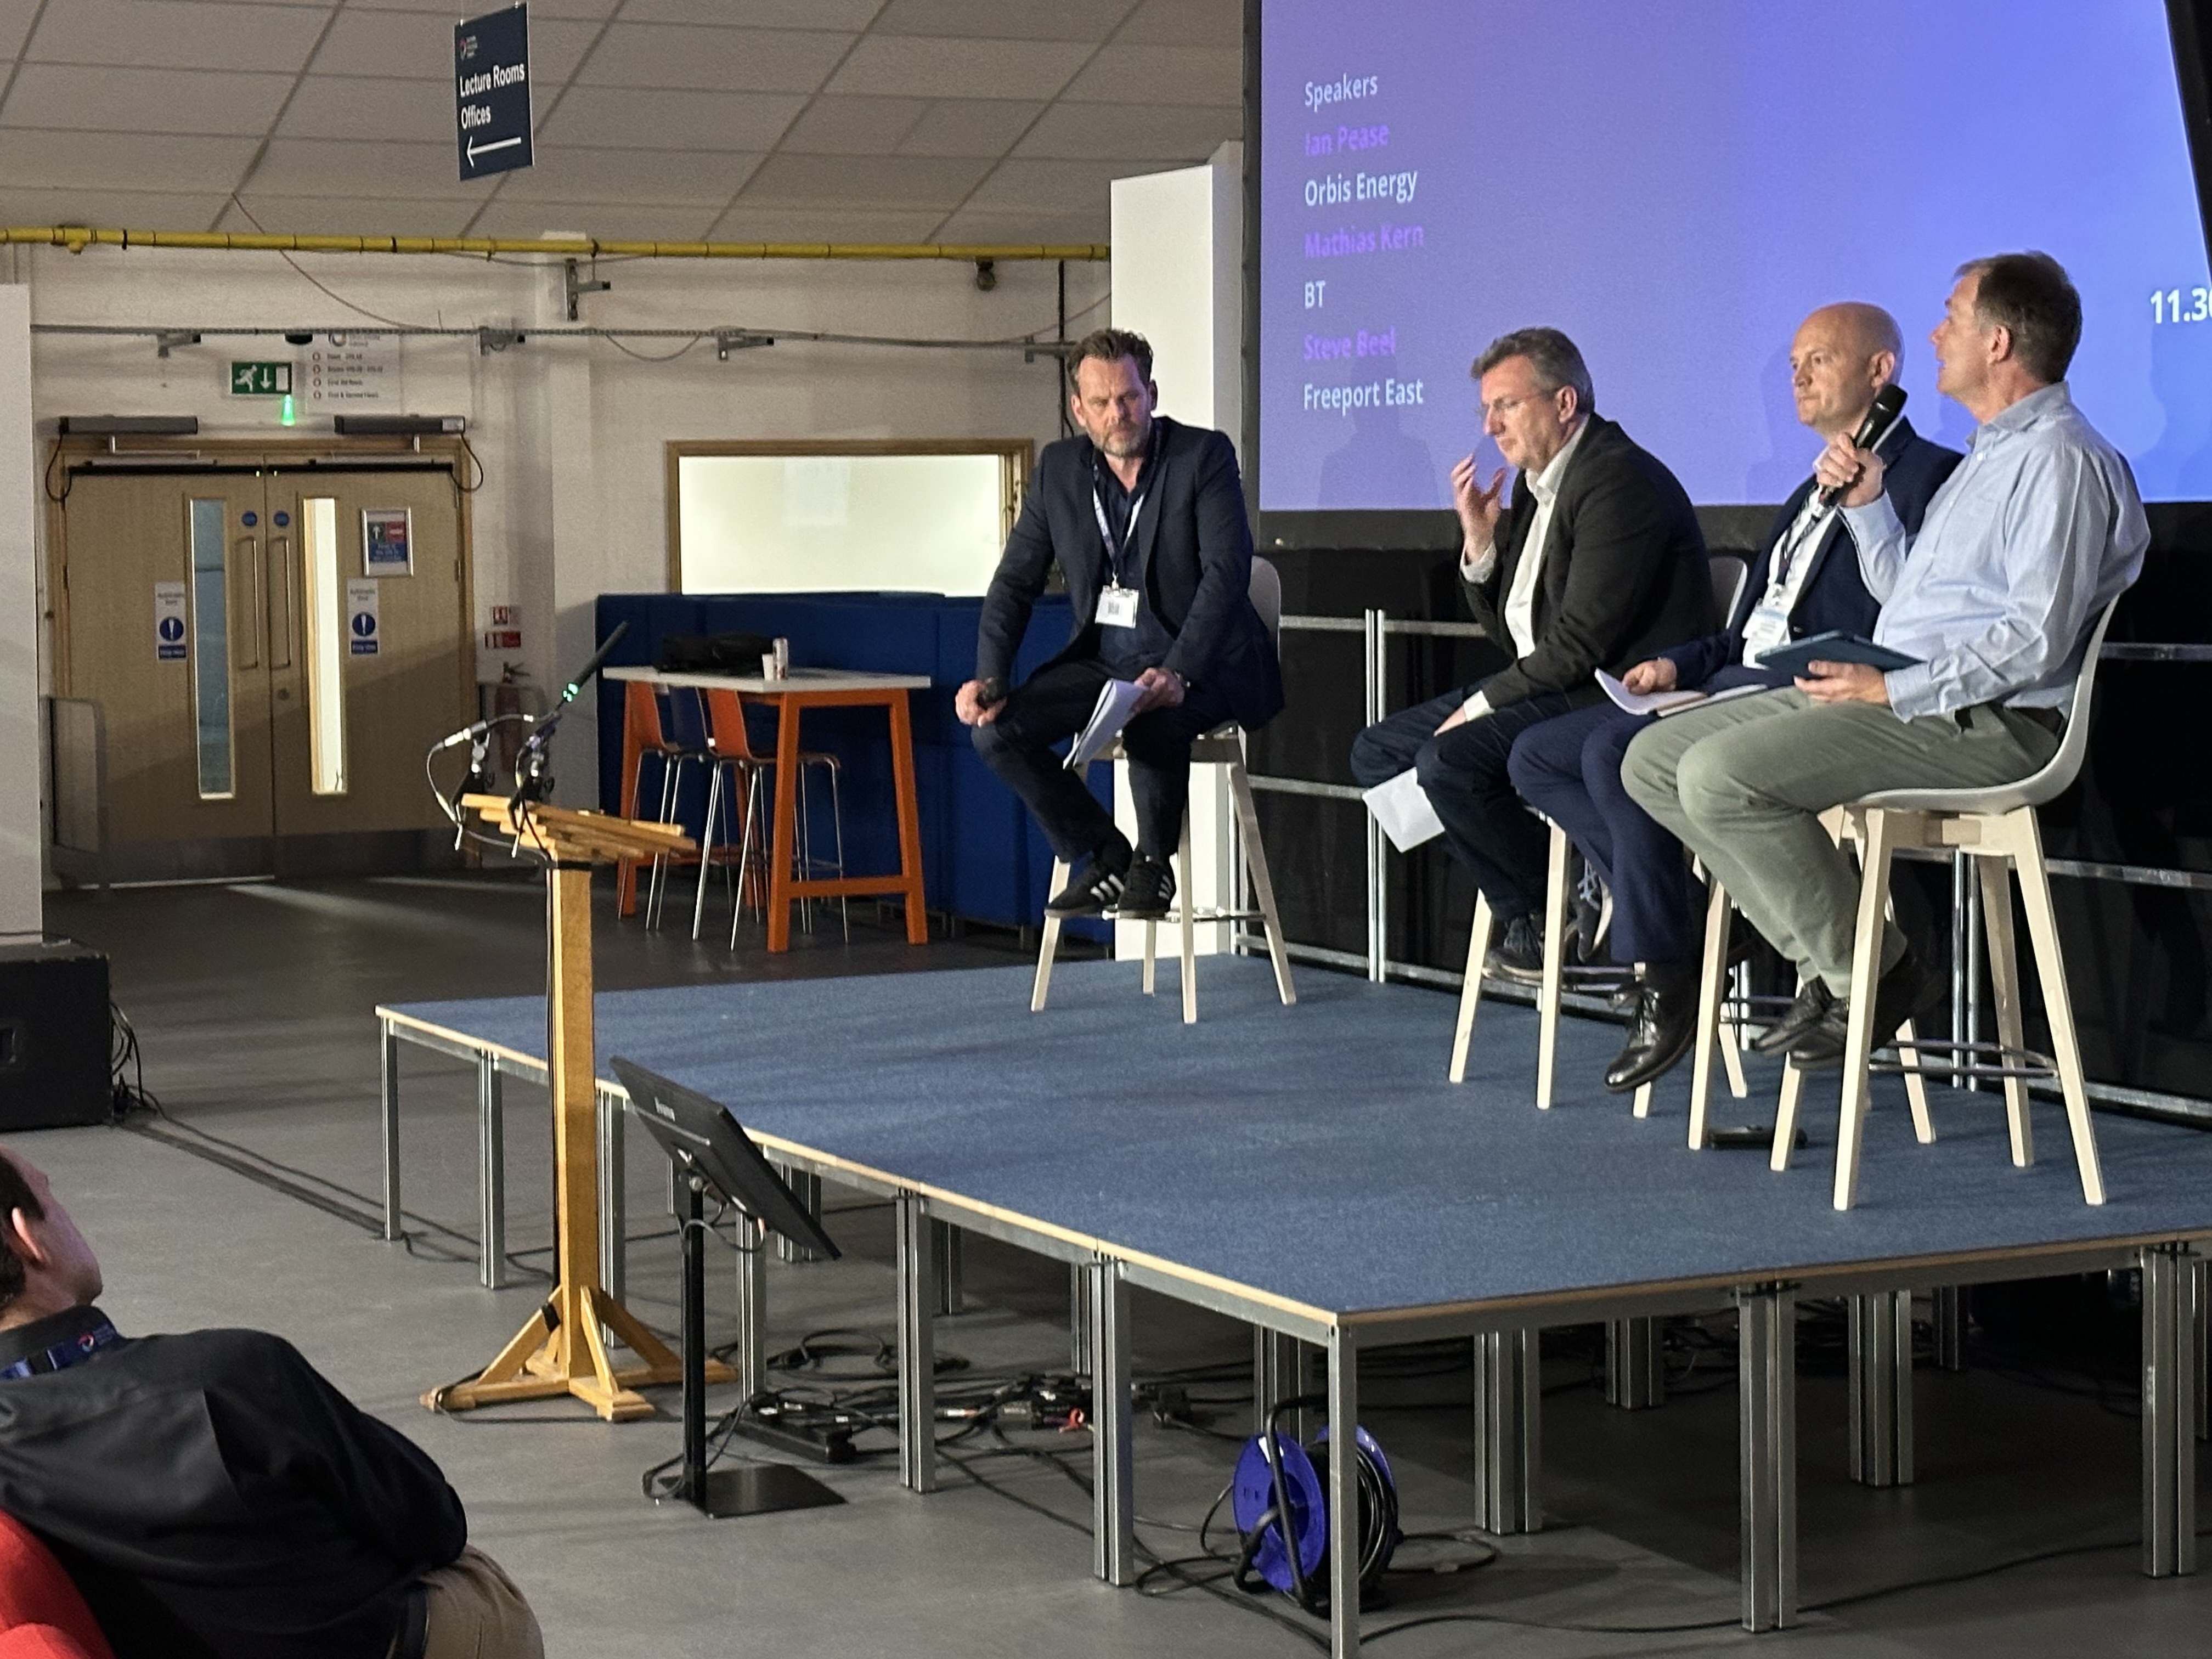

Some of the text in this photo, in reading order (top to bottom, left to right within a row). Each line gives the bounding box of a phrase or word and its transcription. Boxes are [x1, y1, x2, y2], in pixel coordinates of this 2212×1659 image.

[460, 63, 525, 98] Lecture Rooms
[1305, 72, 1378, 112] Speakers
[461, 104, 491, 130] Offices
[1305, 124, 1390, 156] Ian Pease
[1305, 170, 1418, 207] Orbis Energy
[1305, 224, 1423, 258] Mathias Kern
[1304, 280, 1326, 309] BT
[2150, 286, 2212, 324] 11.3
[1305, 327, 1395, 360] Steve Beel
[1304, 377, 1424, 416] Freeport East
